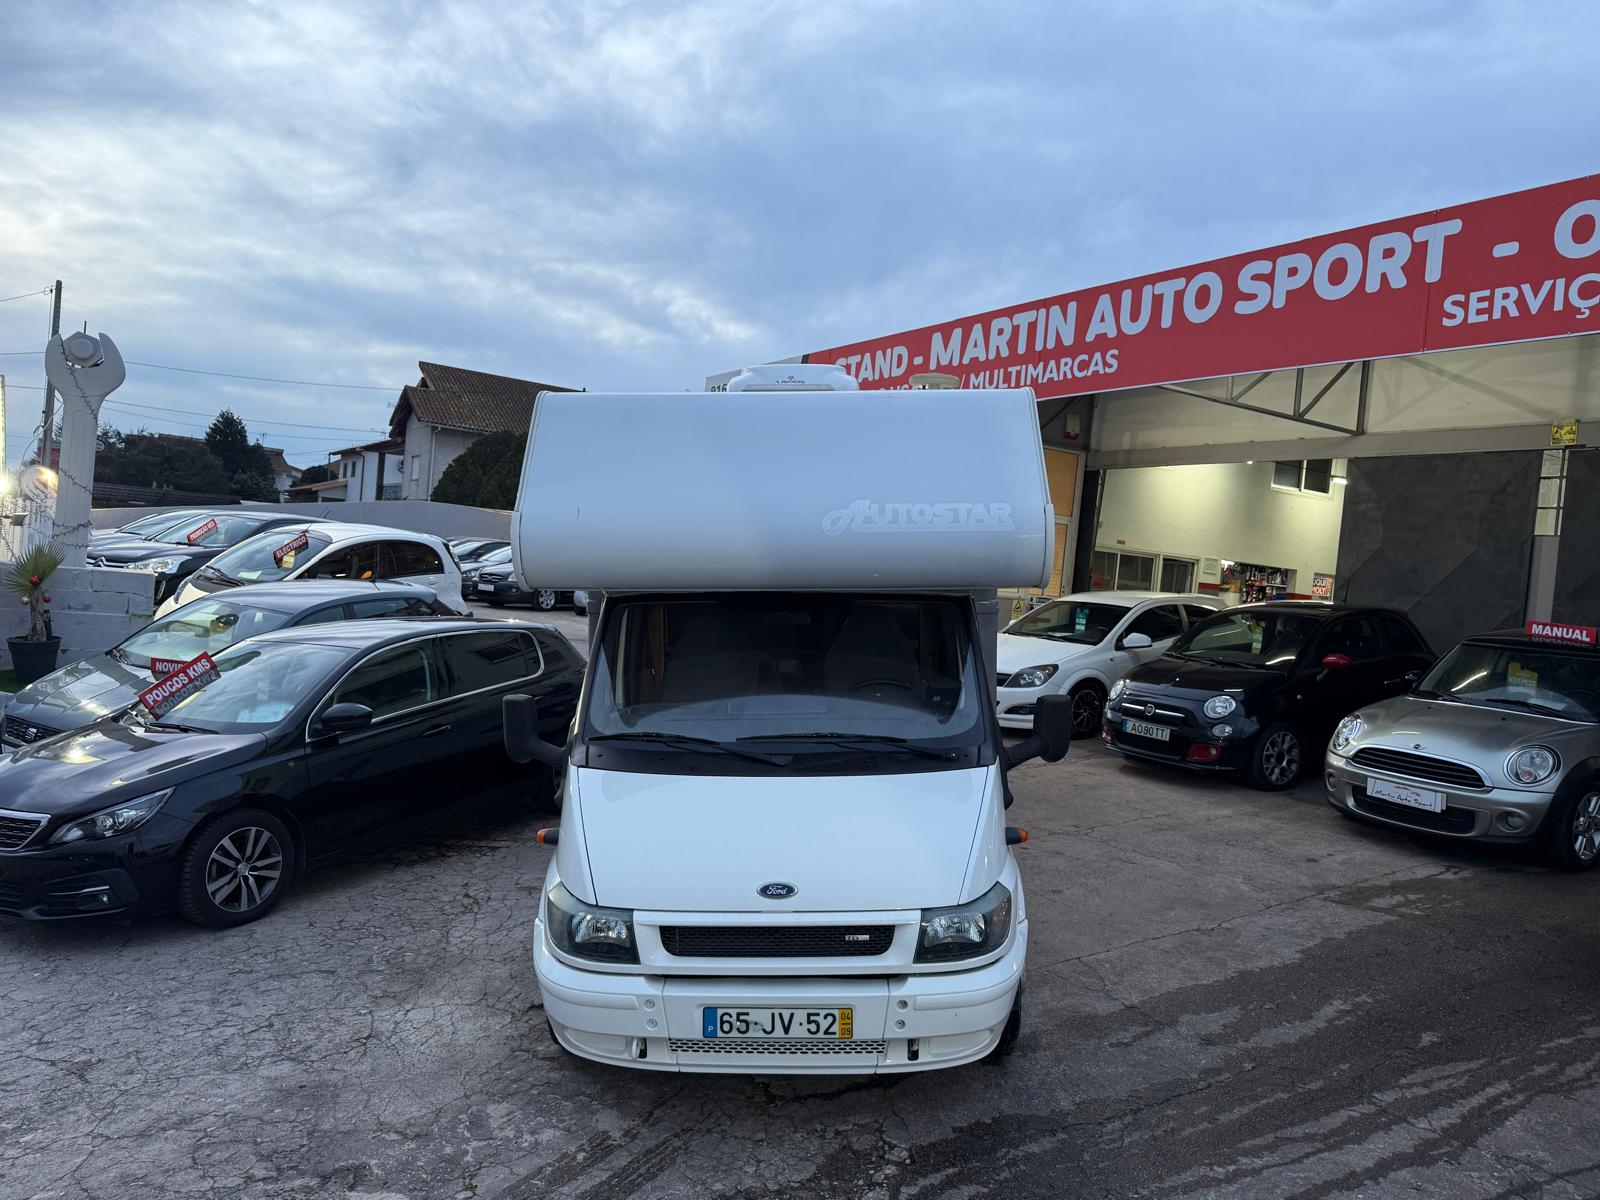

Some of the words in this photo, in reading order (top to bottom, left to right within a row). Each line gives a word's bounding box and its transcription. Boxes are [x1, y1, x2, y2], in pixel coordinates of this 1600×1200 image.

[929, 301, 1077, 370] MARTIN
[1086, 271, 1223, 342] AUTO
[1234, 218, 1463, 315] SPORT
[969, 349, 1119, 389] MULTIMARCAS
[1531, 623, 1590, 641] MANUAL
[145, 672, 188, 705] POUCOS
[186, 658, 211, 679] KMS
[766, 885, 788, 895] Ford
